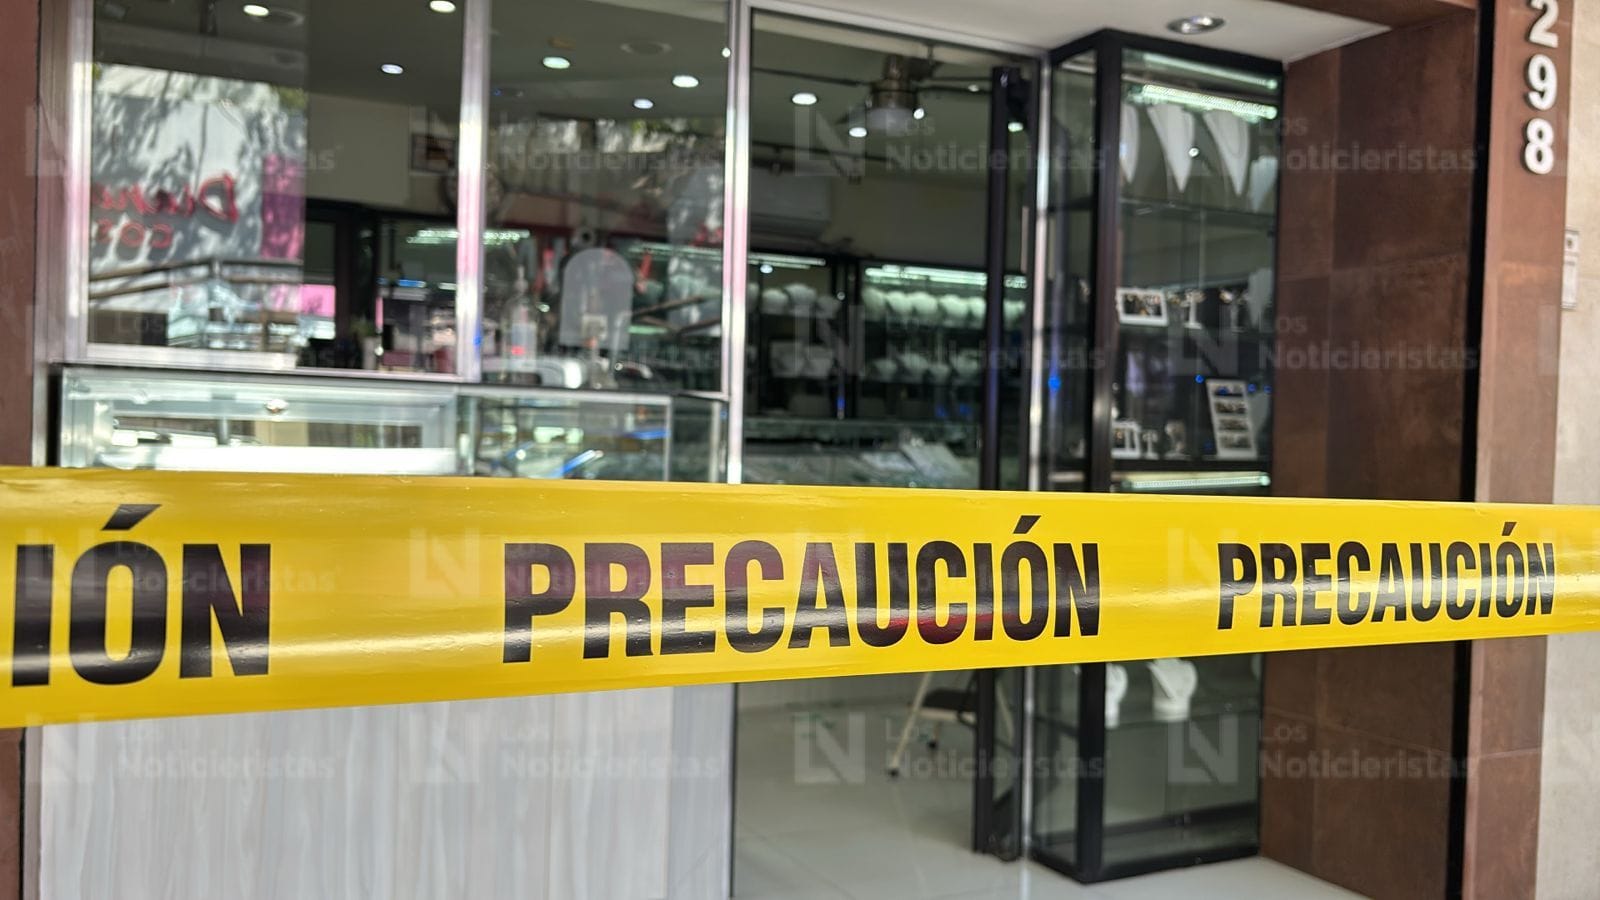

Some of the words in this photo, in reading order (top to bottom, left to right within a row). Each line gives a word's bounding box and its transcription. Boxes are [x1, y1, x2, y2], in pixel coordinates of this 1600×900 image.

[1521, 0, 1559, 174] 298
[12, 503, 272, 687] IÓN
[503, 515, 1101, 663] PRECAUCIÓN
[1218, 520, 1556, 630] PRECAUCIÓN
